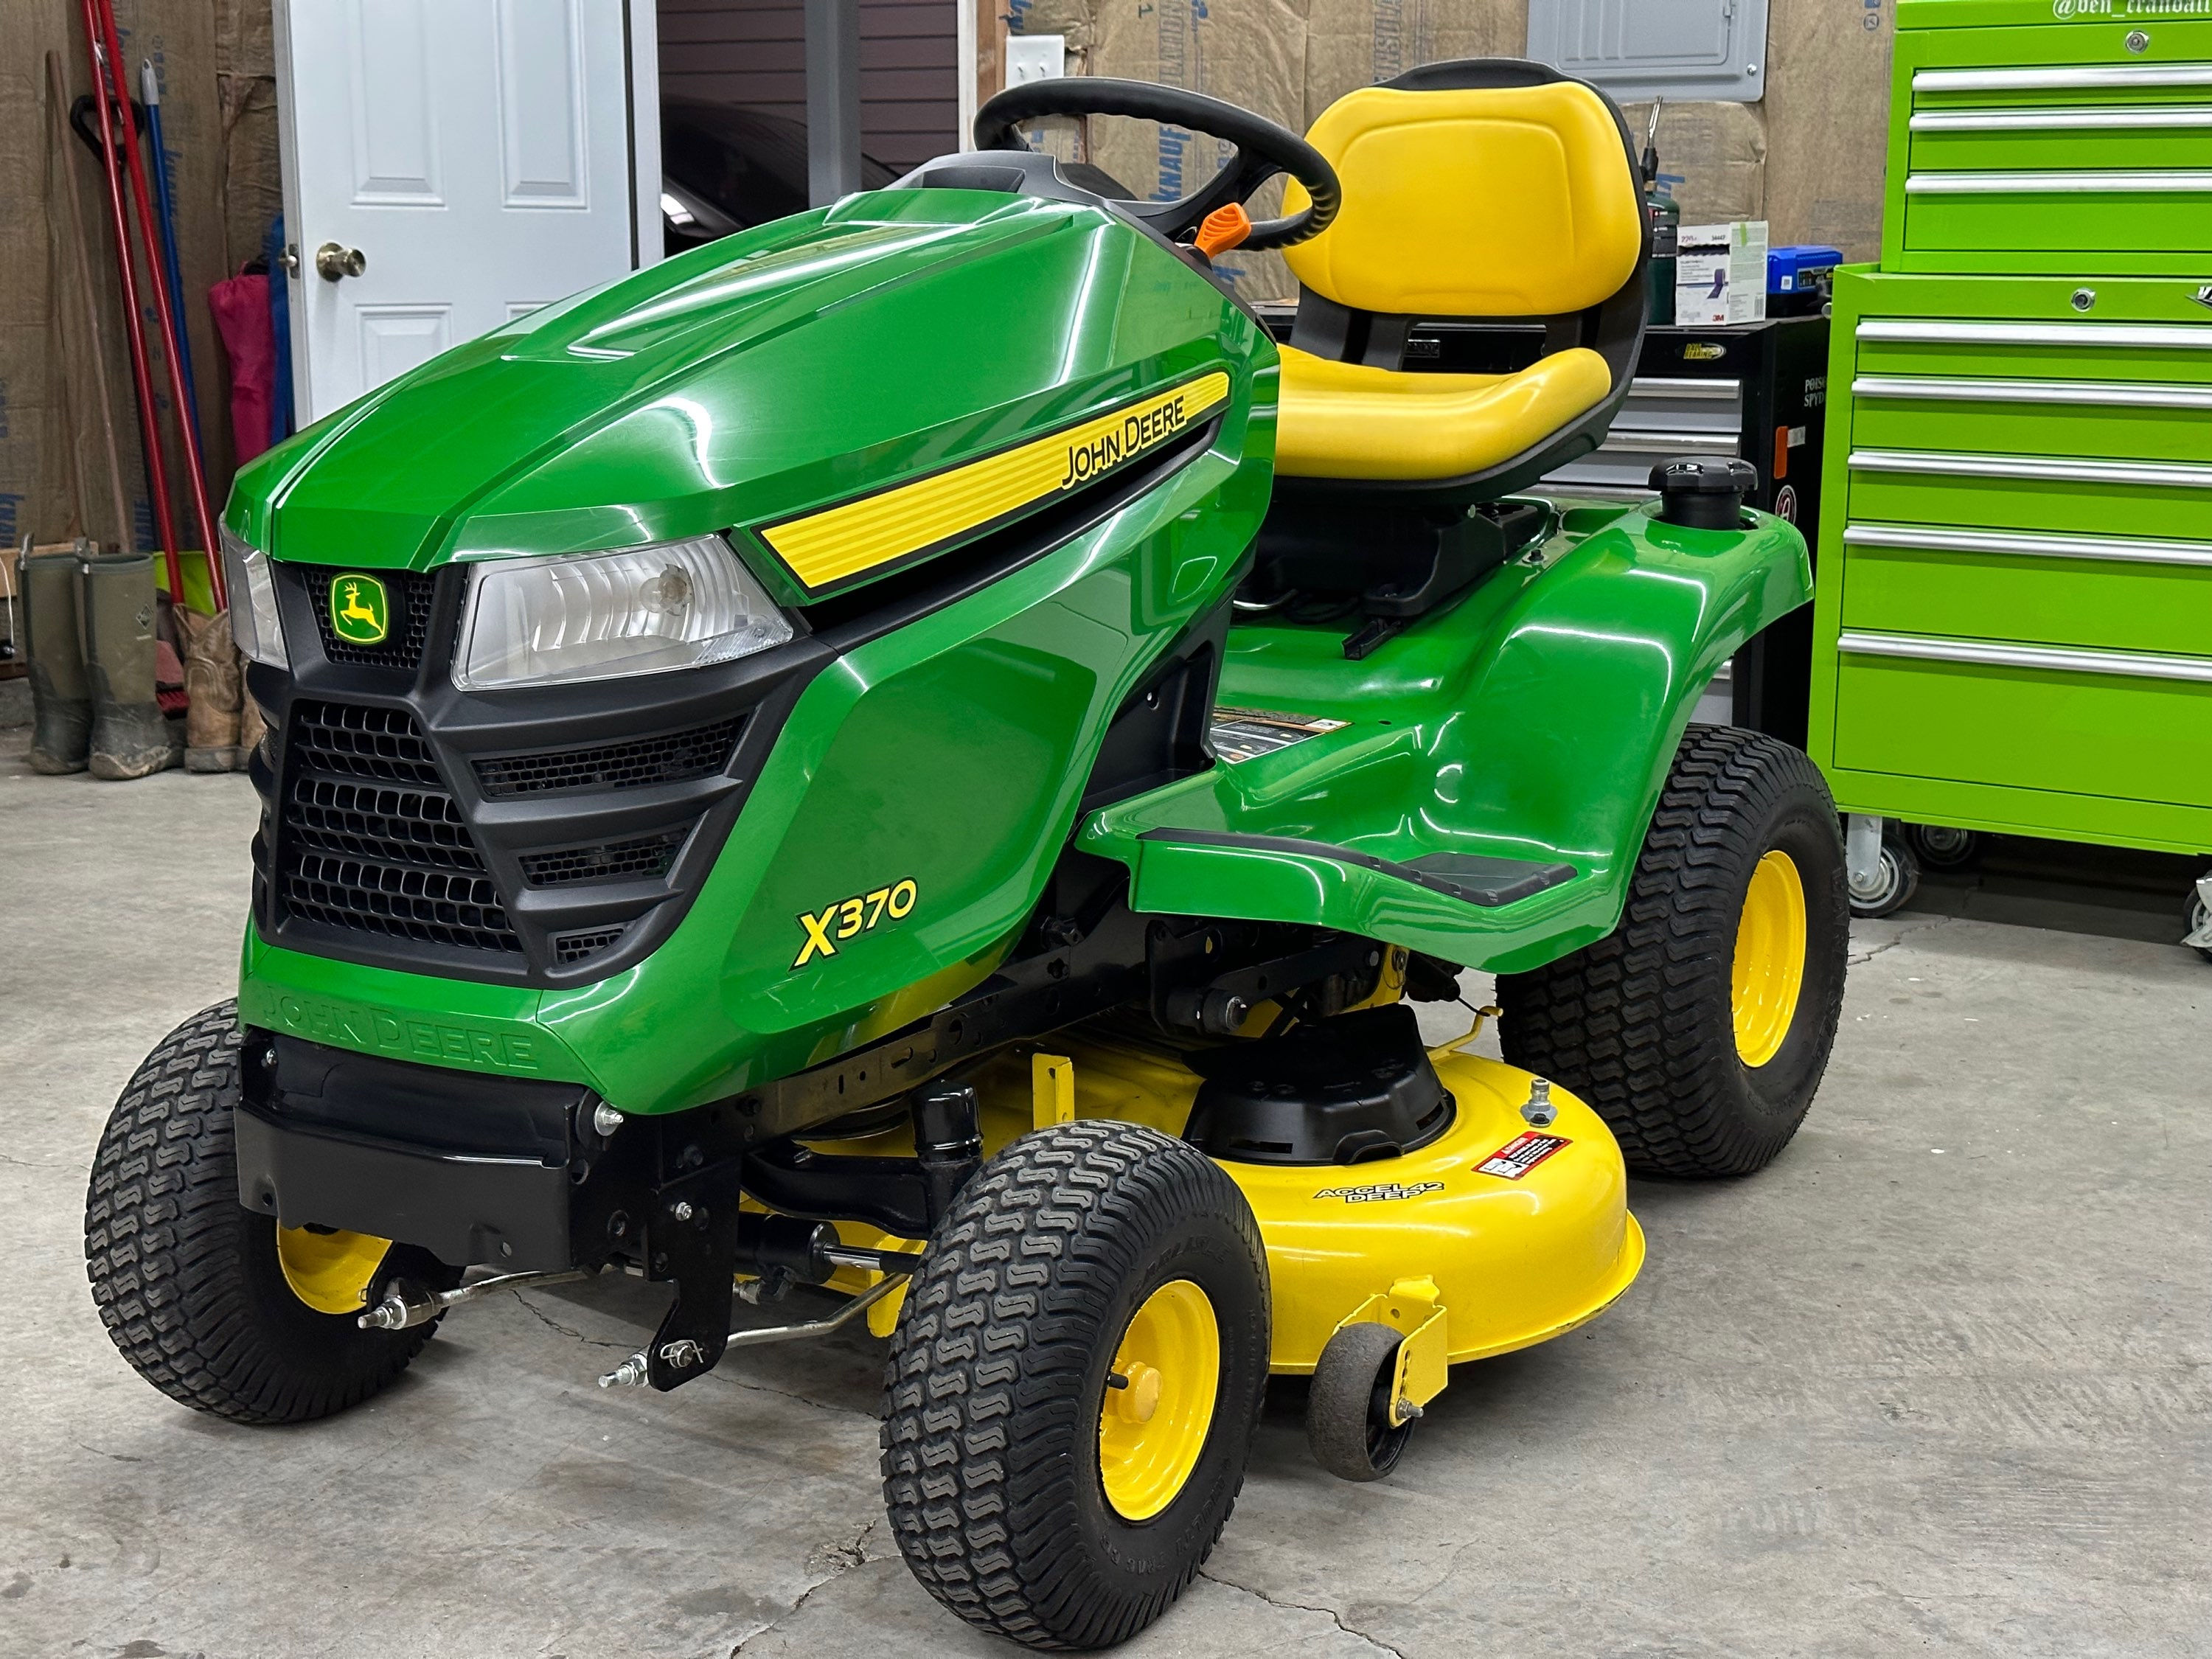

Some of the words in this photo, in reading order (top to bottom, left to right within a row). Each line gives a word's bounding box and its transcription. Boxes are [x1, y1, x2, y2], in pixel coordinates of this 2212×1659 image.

[1712, 314, 1725, 322] 3M
[1804, 392, 1824, 407] SPYD
[1062, 429, 1122, 488] JOHN
[1124, 394, 1186, 457] DEERE
[789, 877, 918, 971] X370
[264, 985, 367, 1044] JOHN
[370, 1006, 539, 1070] DEERE
[1313, 1183, 1408, 1198] ACCEL
[1406, 1181, 1444, 1192] 42
[1345, 1190, 1423, 1203] DEEP
